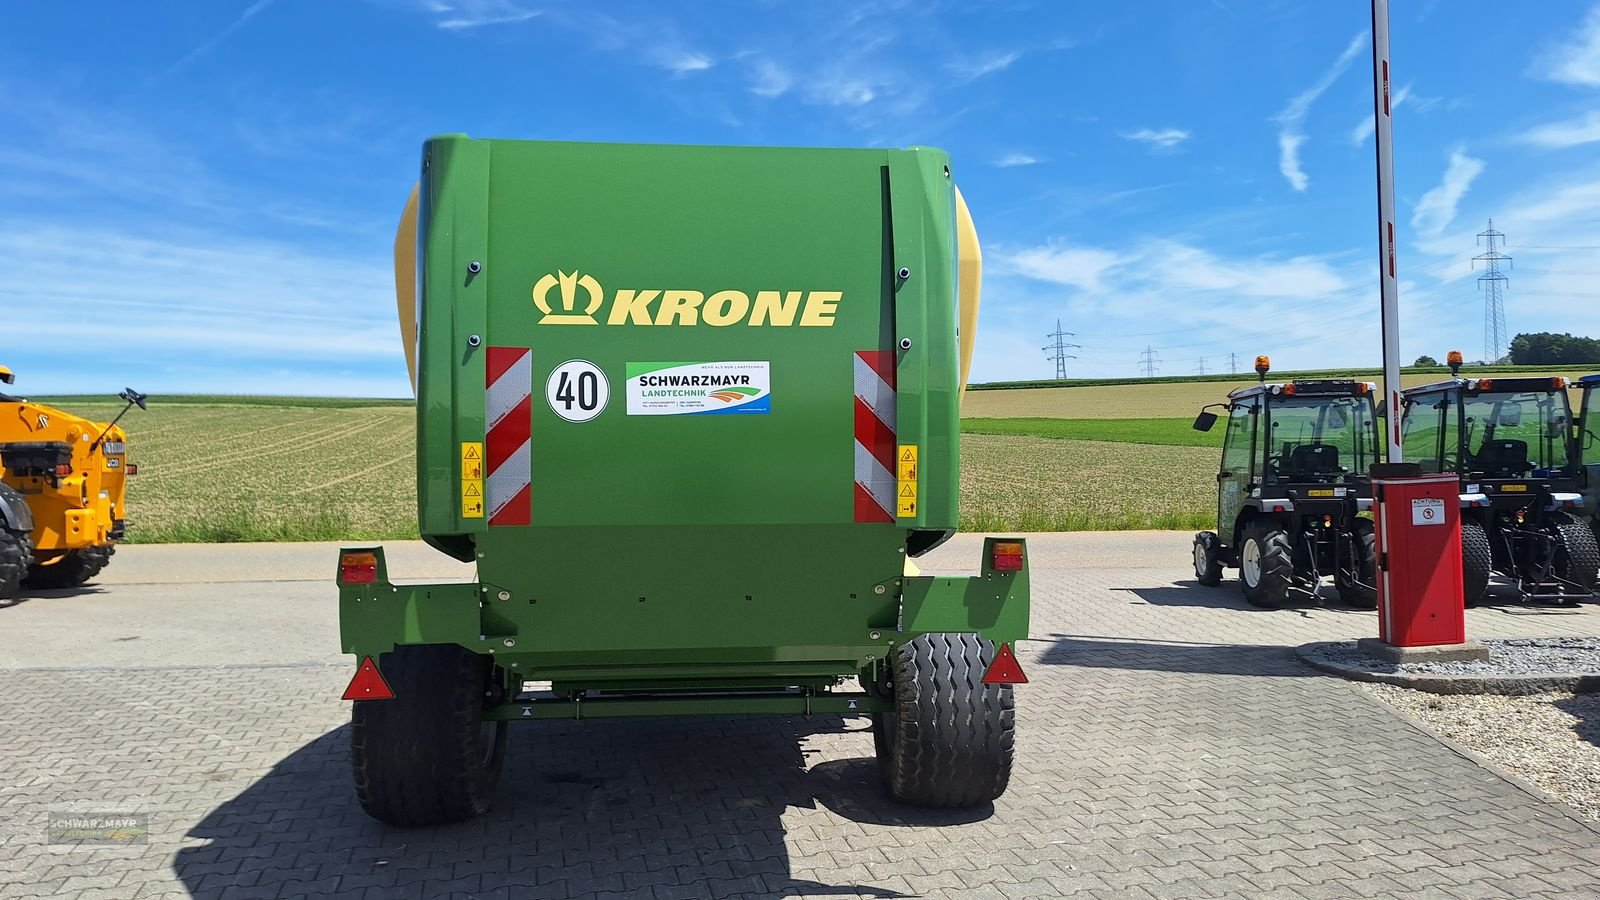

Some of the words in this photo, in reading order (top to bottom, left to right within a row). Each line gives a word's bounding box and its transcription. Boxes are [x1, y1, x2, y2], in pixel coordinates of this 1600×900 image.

[607, 289, 843, 327] KRONE
[555, 371, 598, 411] 40
[639, 375, 750, 387] SCHWARZMAYR
[642, 389, 706, 397] LANDTECHNIK
